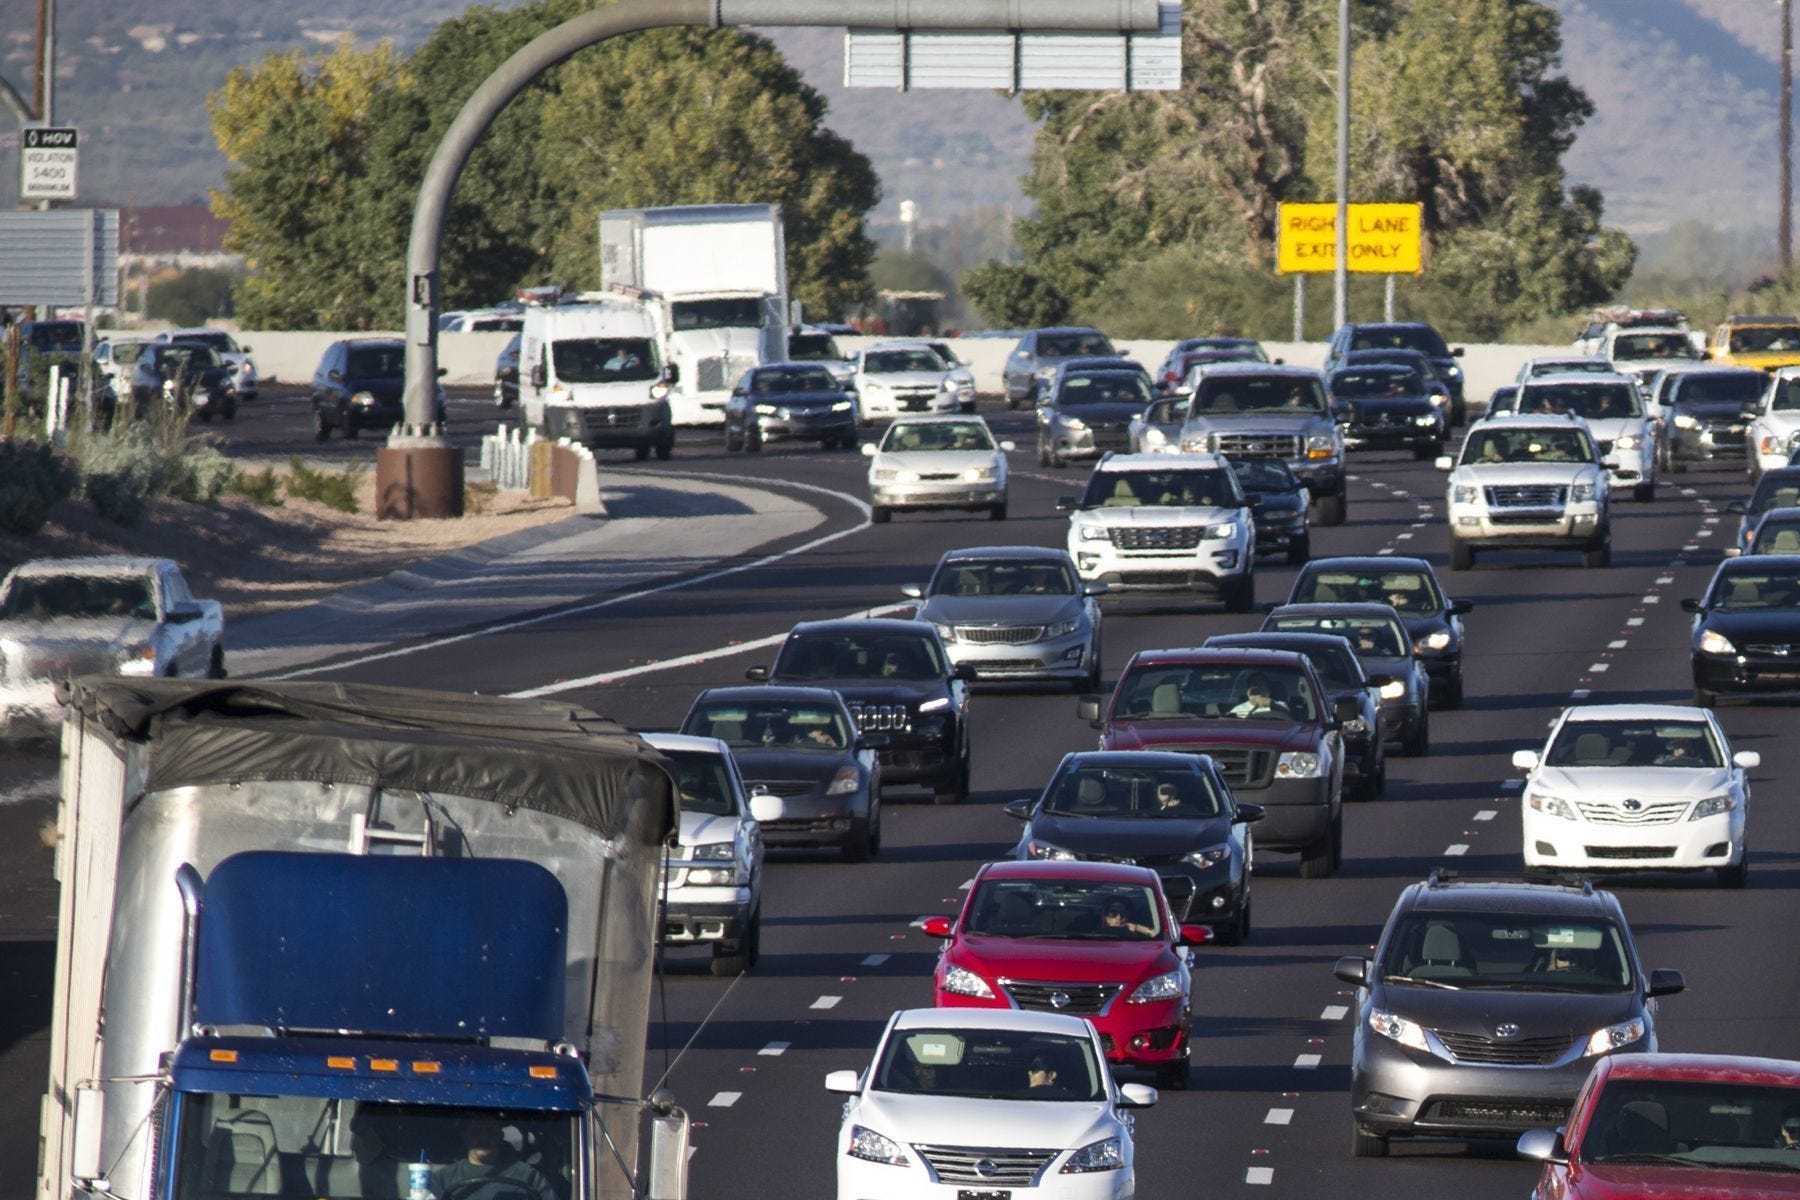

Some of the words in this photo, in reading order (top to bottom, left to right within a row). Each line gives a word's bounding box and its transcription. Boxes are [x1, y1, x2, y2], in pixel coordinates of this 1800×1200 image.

[42, 132, 73, 145] HOV
[1290, 217, 1340, 232] RIGH
[1360, 216, 1410, 233] LANE
[1352, 243, 1402, 259] ONLY
